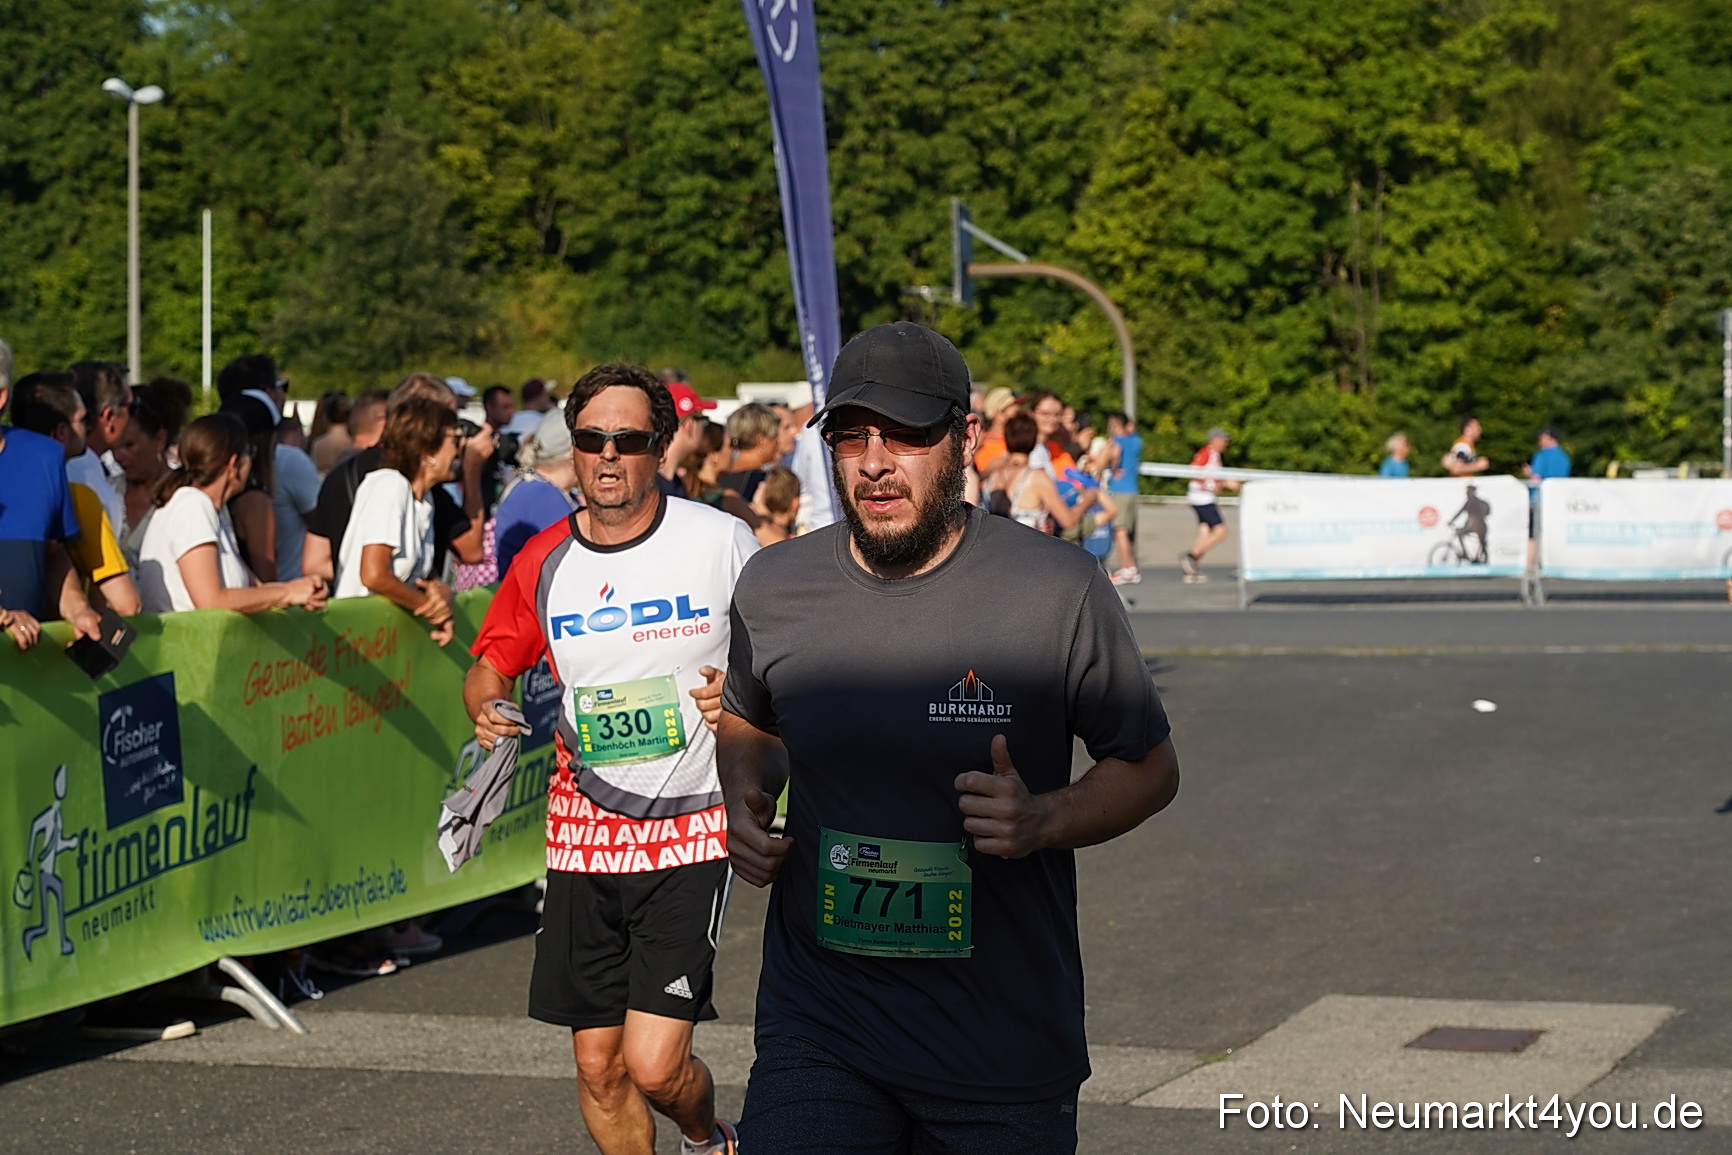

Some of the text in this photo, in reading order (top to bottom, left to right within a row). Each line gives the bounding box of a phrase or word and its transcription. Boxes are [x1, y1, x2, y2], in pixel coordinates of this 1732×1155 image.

[551, 581, 709, 640] RÖDL
[633, 616, 711, 642] energie
[243, 626, 398, 706] Gesunde Firmen
[281, 694, 338, 752] laufen
[597, 709, 652, 740] 330
[664, 708, 680, 746] 2022
[929, 703, 1012, 715] BURKHARDT
[114, 720, 163, 757] Fischer
[581, 723, 593, 752] RUN
[592, 735, 669, 753] Ebenhöch Martin
[76, 763, 258, 910] firmenlauf
[851, 858, 898, 869] Firmenlauf
[82, 885, 156, 941] neumarkt
[823, 884, 835, 924] RUN
[850, 877, 922, 920] 771
[948, 889, 962, 941] 2022
[833, 915, 947, 934] Dietmayer Matthias
